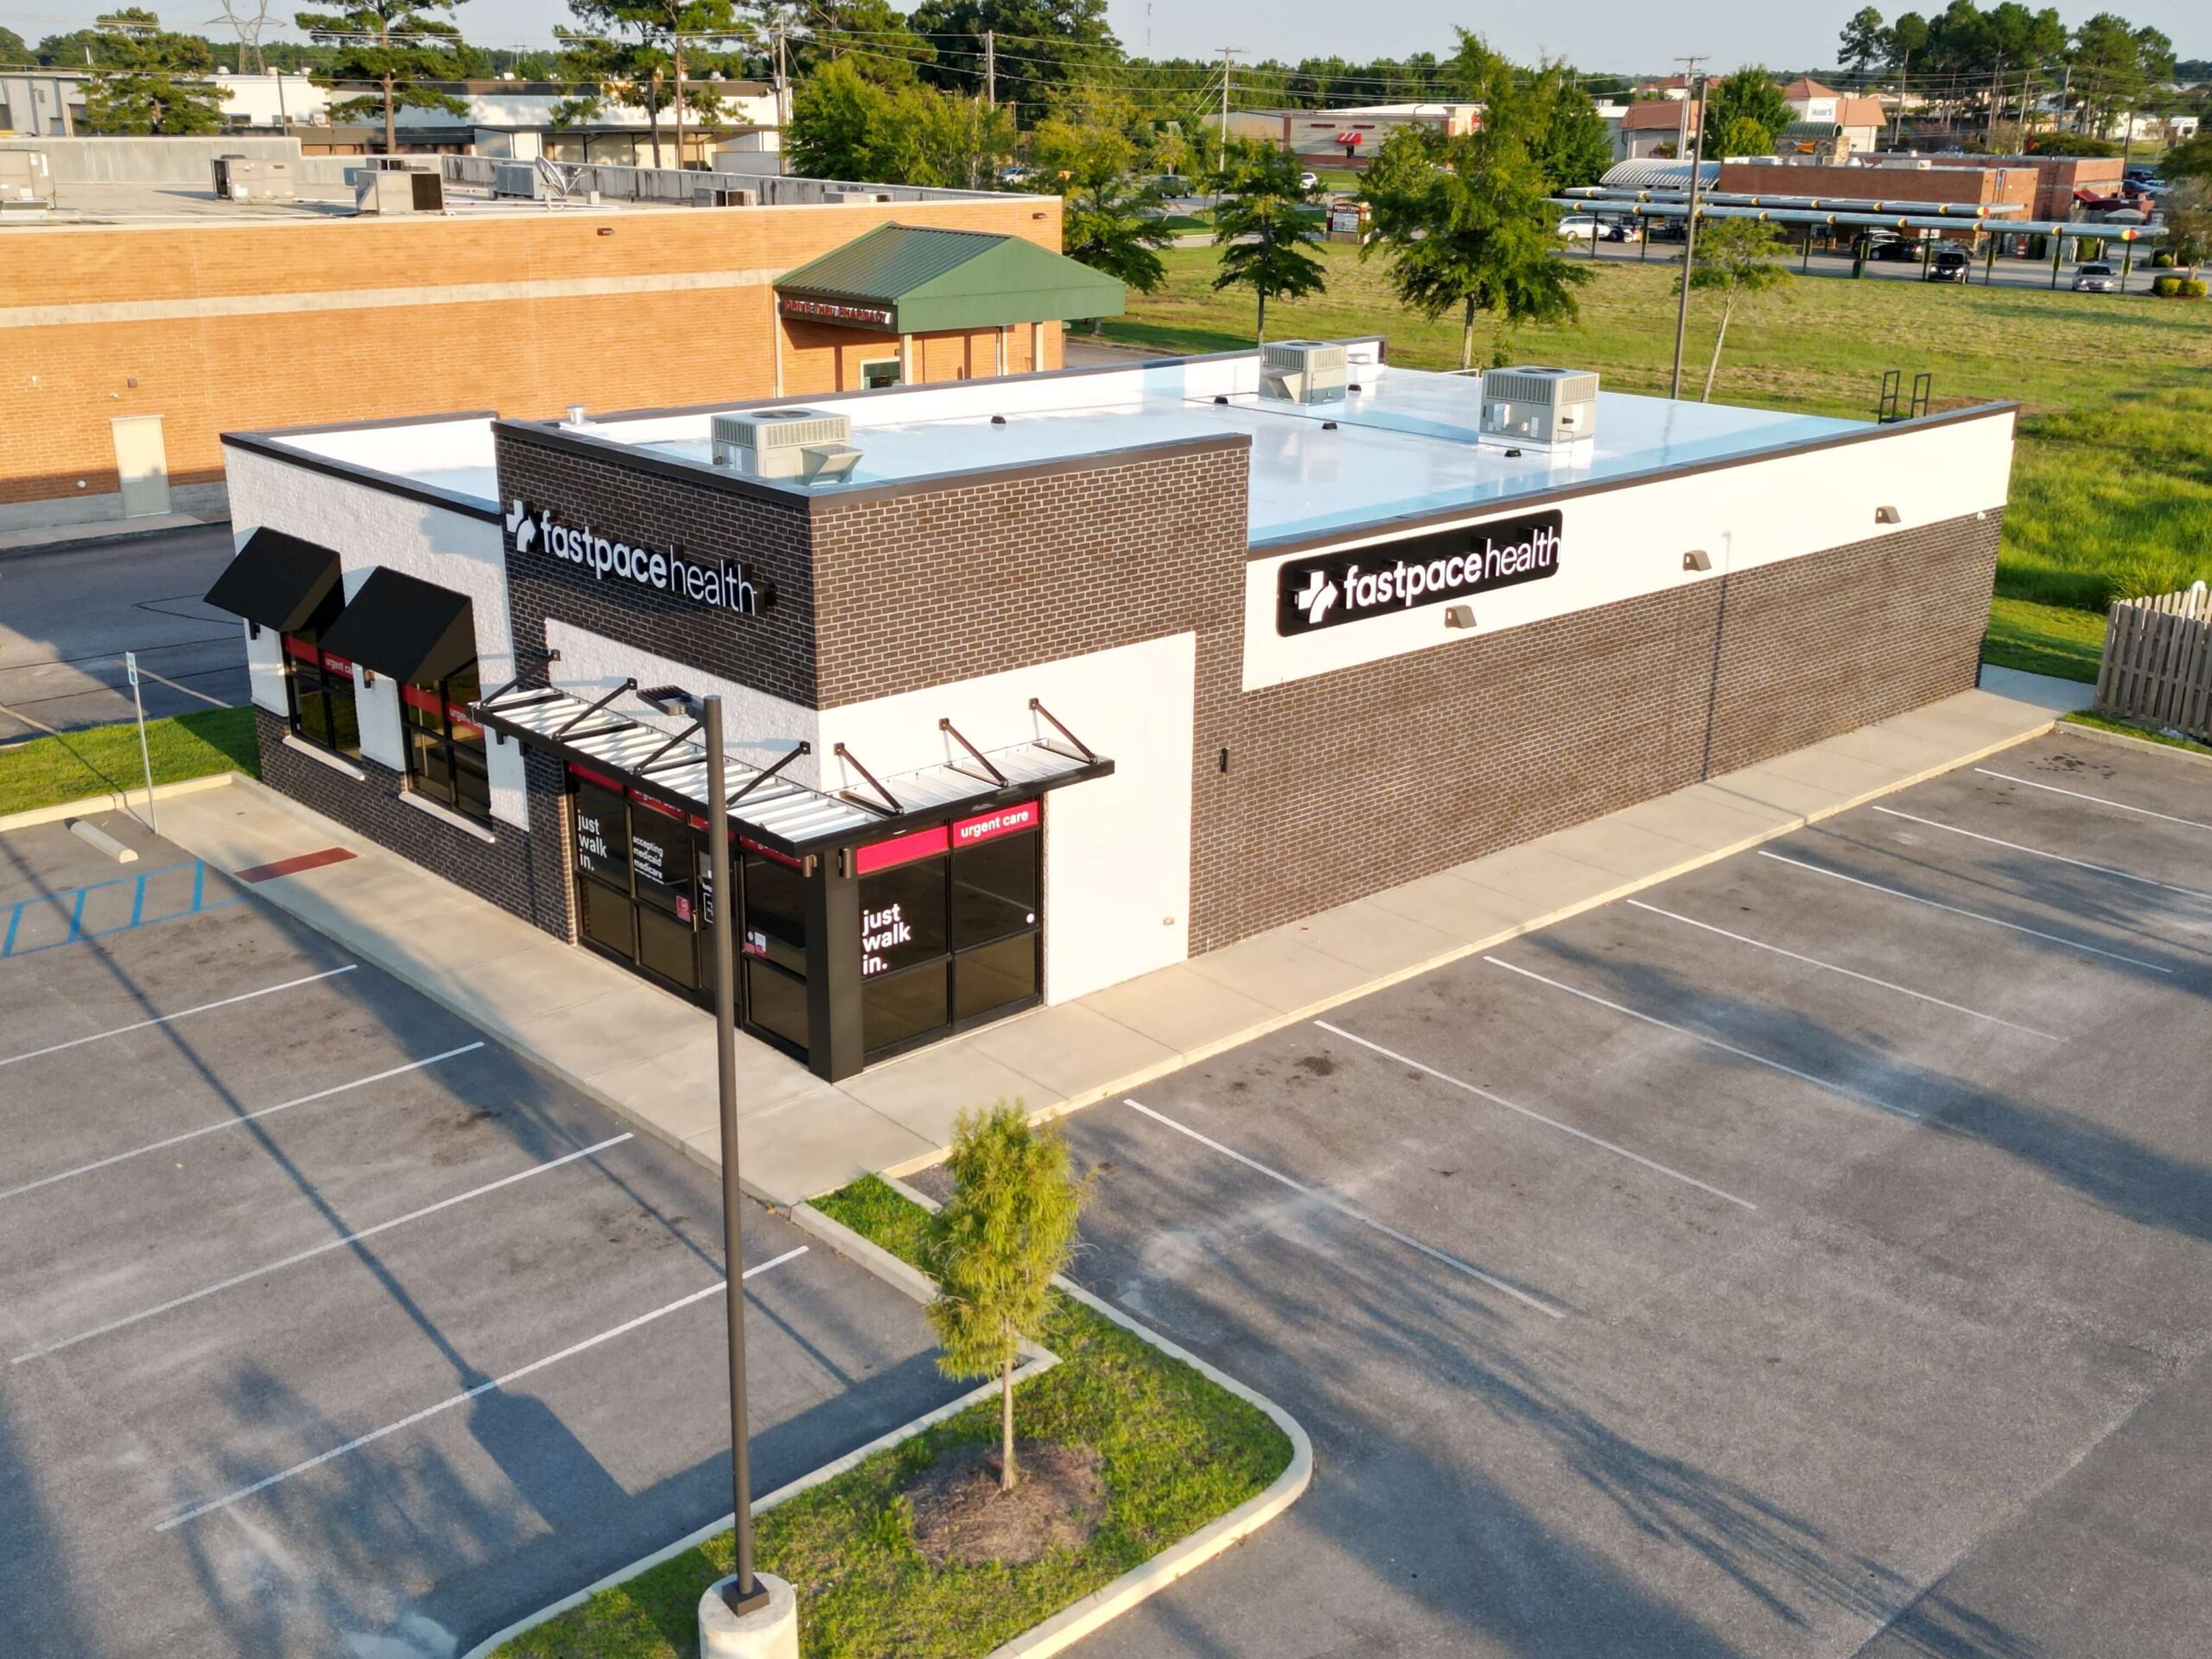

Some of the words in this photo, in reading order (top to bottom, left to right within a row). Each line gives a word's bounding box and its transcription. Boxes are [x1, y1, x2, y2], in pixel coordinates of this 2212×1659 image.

[577, 808, 601, 836] just
[961, 816, 1001, 838] urgent
[1002, 810, 1029, 826] care
[578, 833, 607, 858] walk
[579, 848, 595, 871] in.
[862, 903, 901, 937] just
[861, 922, 912, 953] walk
[861, 954, 888, 976] in.
